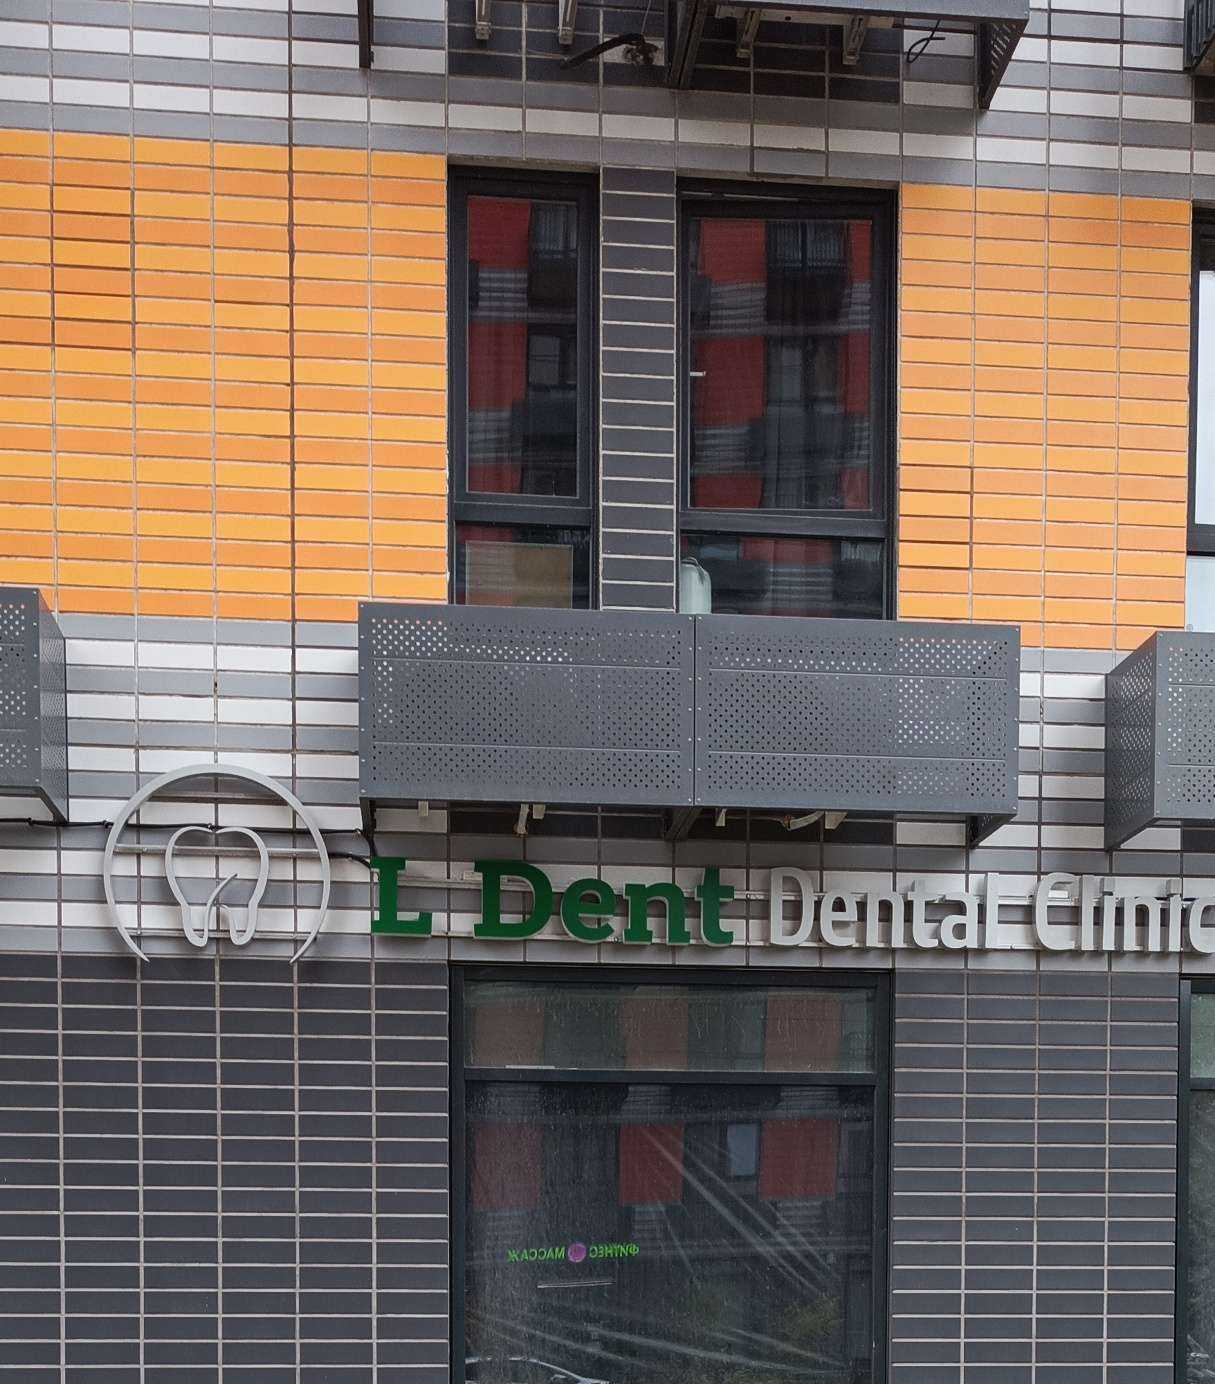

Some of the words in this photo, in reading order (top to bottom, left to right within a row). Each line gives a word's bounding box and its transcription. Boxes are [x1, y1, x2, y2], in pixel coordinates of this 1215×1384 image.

[370, 857, 432, 937] L
[473, 859, 735, 947] Dent
[769, 866, 1000, 949] Dental
